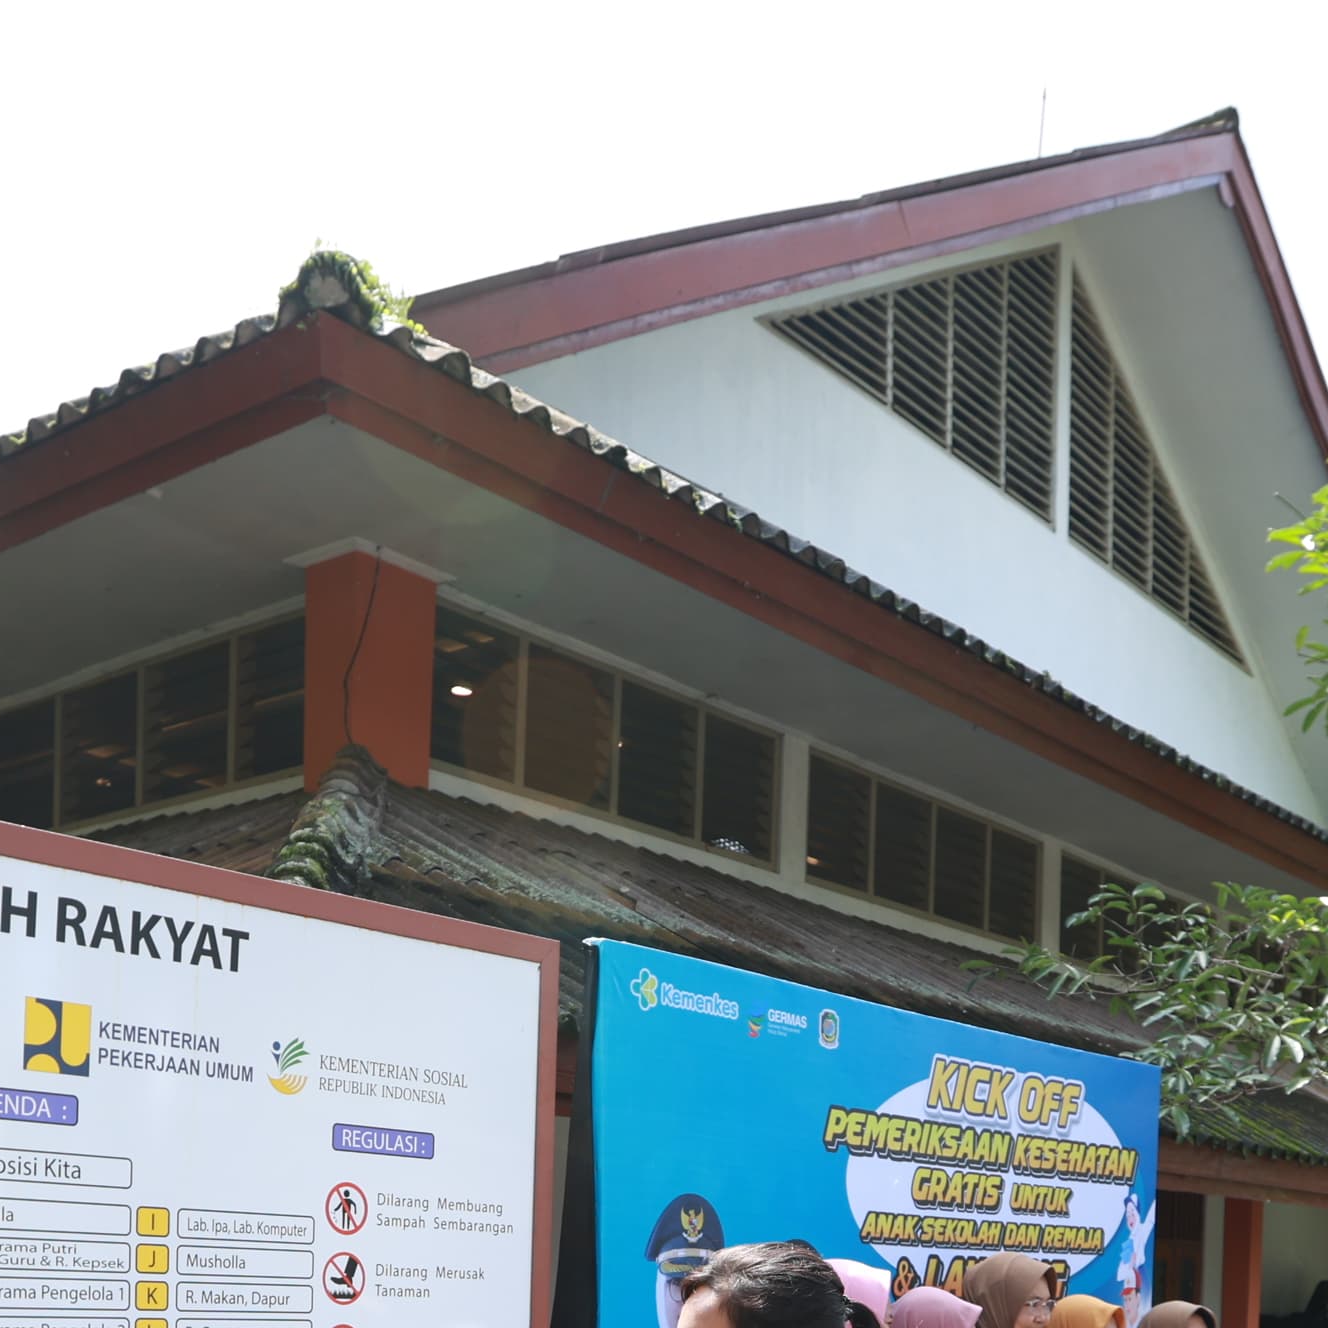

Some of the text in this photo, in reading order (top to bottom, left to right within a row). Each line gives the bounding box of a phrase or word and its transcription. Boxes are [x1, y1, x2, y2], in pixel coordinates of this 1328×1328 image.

[56, 897, 250, 973] RAKYAT
[661, 982, 739, 1020] Kemenkes
[767, 1009, 808, 1029] GERMAS
[99, 1020, 220, 1053] KEMENTERIAN
[98, 1047, 254, 1082] PEKERJAAN UMUM
[319, 1054, 468, 1088] KEMENTERIAN SOSIAL
[319, 1076, 446, 1105] REPUBLIK INDONESIA
[926, 1056, 1082, 1128] KICK OFF
[342, 1128, 417, 1153] REGULASI
[823, 1106, 1138, 1181] PEMERIKSAAN KESEHATAN
[44, 1158, 81, 1179] Kita
[912, 1166, 1072, 1214] GRATIS UNTUK
[377, 1192, 503, 1216] Dilarang Membuang
[187, 1218, 307, 1239] Lab. Ipa, Lab. Komputer
[376, 1213, 513, 1236] Sampah Sembarangan
[861, 1211, 1104, 1252] ANAK SEKOLAH DAN REMAJA
[42, 1242, 77, 1254] Putri
[148, 1250, 156, 1268] J
[40, 1256, 51, 1266] &
[55, 1256, 68, 1267] R.
[72, 1257, 124, 1270] Kepsek
[186, 1254, 246, 1269] Musholla
[376, 1263, 485, 1281] Dilarang Merusak
[893, 1257, 919, 1298] &
[41, 1284, 112, 1304] Pengelola
[147, 1288, 158, 1304] K
[186, 1290, 290, 1309] R. Makan, Dapur
[375, 1284, 430, 1298] Tanaman
